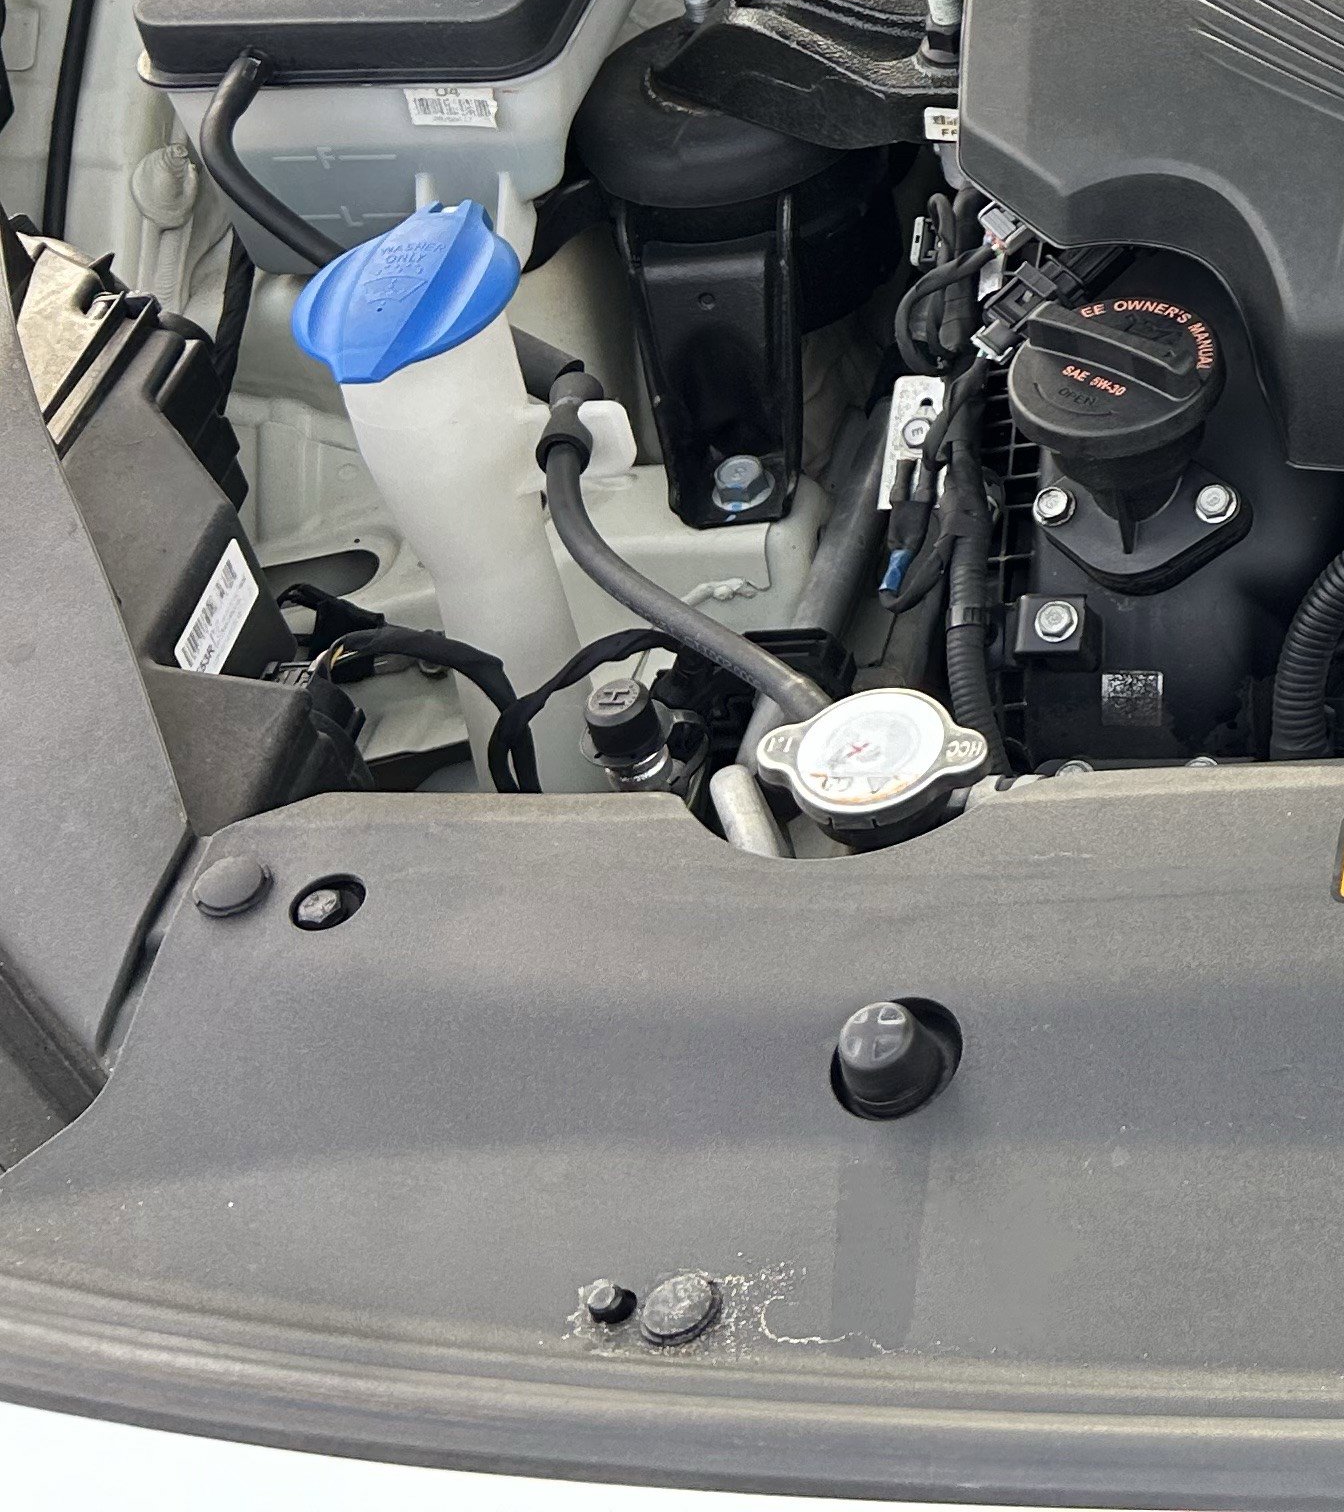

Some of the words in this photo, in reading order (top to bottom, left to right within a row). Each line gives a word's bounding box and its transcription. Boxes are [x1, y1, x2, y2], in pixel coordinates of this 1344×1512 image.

[316, 146, 336, 170] F
[340, 205, 364, 228] L
[381, 241, 447, 254] WASHER
[385, 253, 428, 265] ONLY
[1080, 303, 1107, 319] EE
[1113, 299, 1193, 324] OWNER'S
[1187, 322, 1216, 370] MANUAL
[1061, 365, 1091, 383] SAE
[1089, 376, 1128, 397] 5W-30
[1058, 388, 1098, 406] OPEN
[945, 740, 983, 757] HCC
